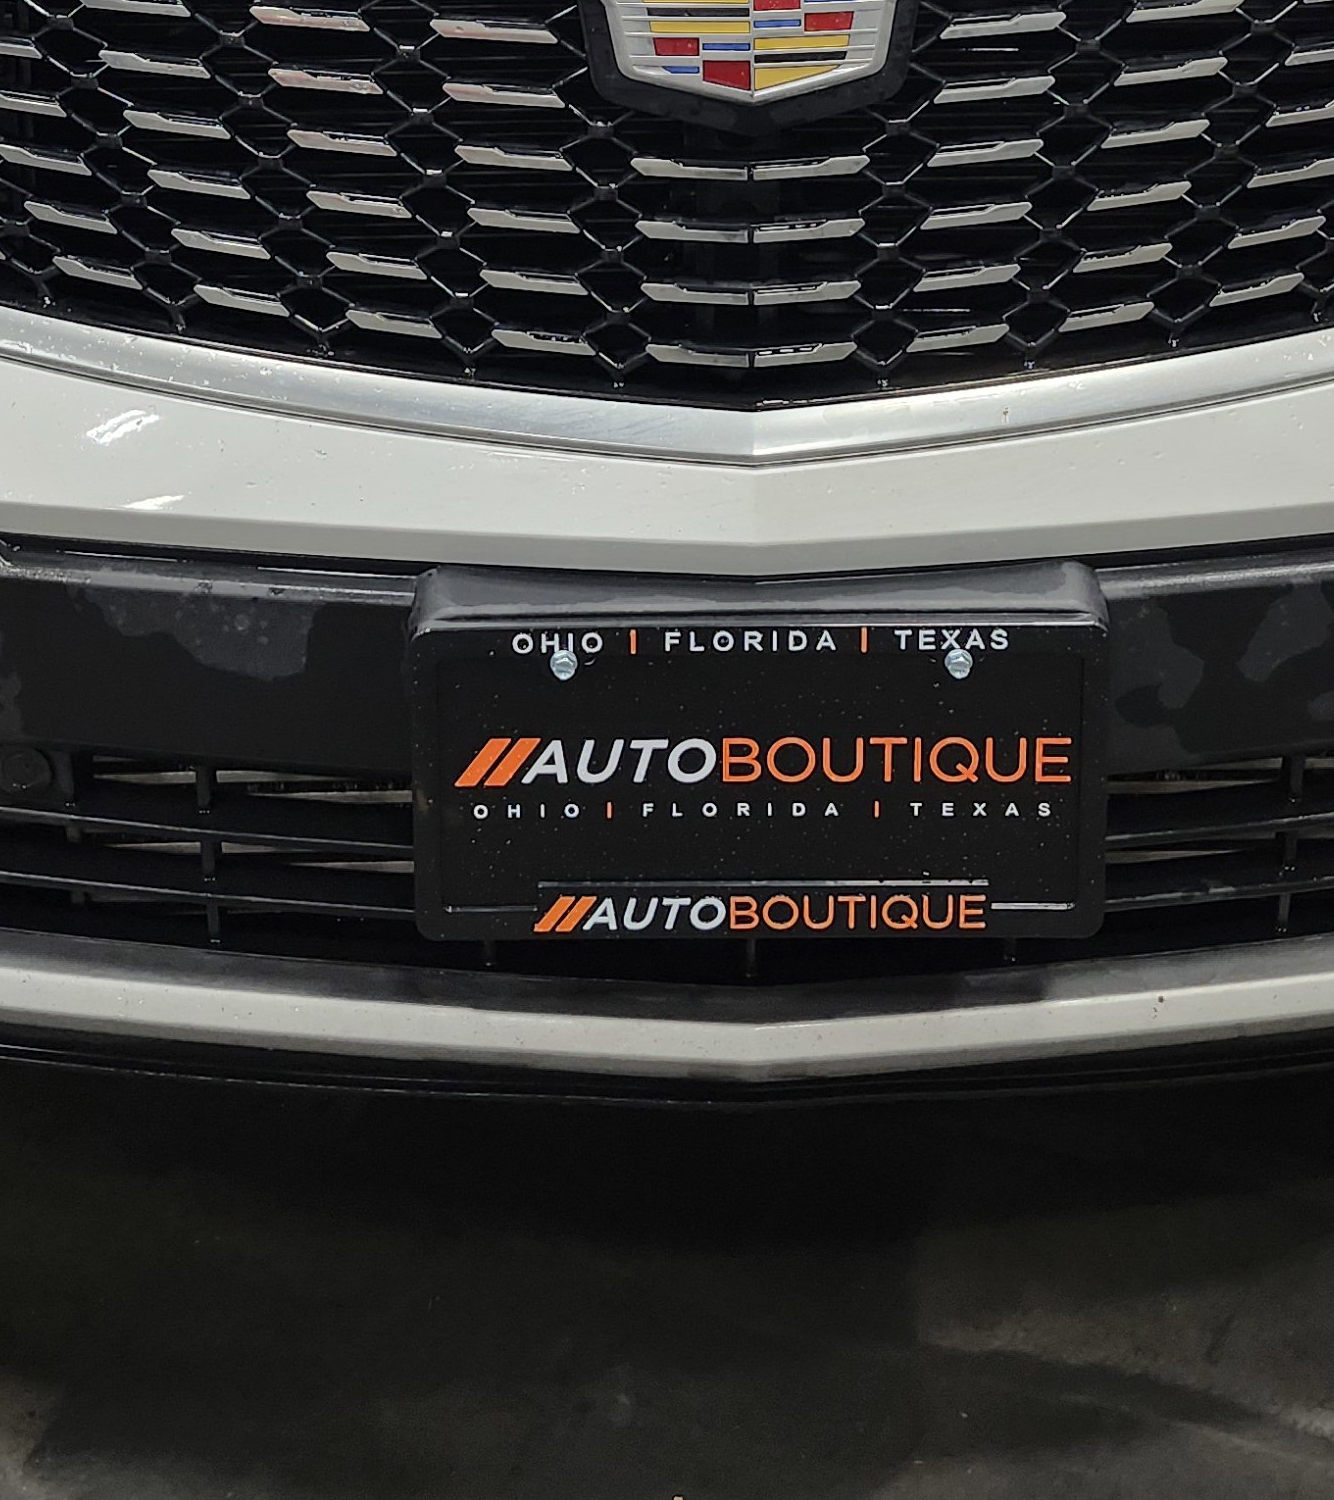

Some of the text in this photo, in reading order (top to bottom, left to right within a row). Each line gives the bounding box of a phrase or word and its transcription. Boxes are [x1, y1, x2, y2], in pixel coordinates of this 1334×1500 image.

[511, 628, 1009, 655] OHIO FLORIDA TEXAS
[521, 736, 1073, 784] AUTOBOUTIQUE
[473, 802, 1051, 820] OHIO FLORIDA TEXAS
[582, 894, 987, 932] AUTOBOUTIQUE
